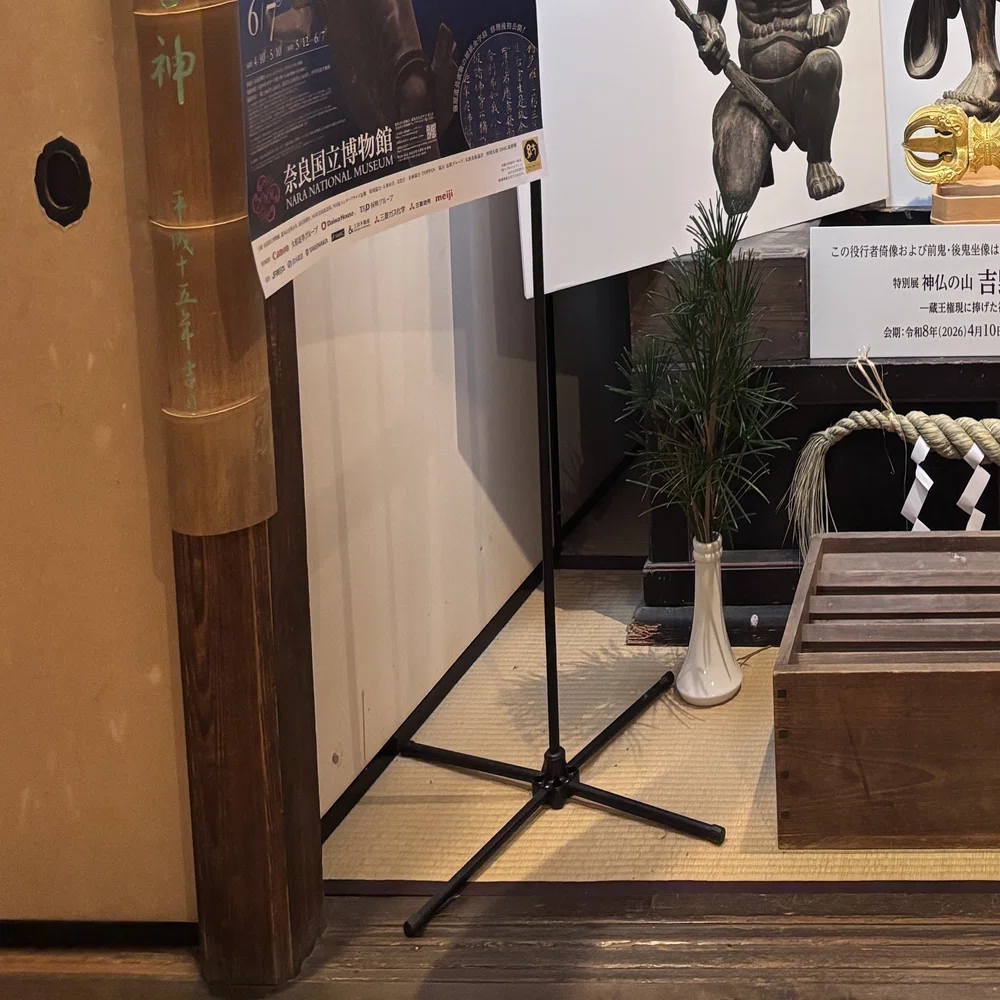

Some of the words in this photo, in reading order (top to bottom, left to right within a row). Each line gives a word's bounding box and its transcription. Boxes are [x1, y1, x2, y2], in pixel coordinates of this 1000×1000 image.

[283, 125, 393, 196] 奈良国立博物館
[285, 189, 308, 210] NARA
[308, 170, 352, 198] NATIONAL
[353, 155, 394, 178] MUSEUM
[435, 189, 454, 202] meiji
[893, 276, 919, 289] 特別展
[921, 273, 973, 292] 神仏の山
